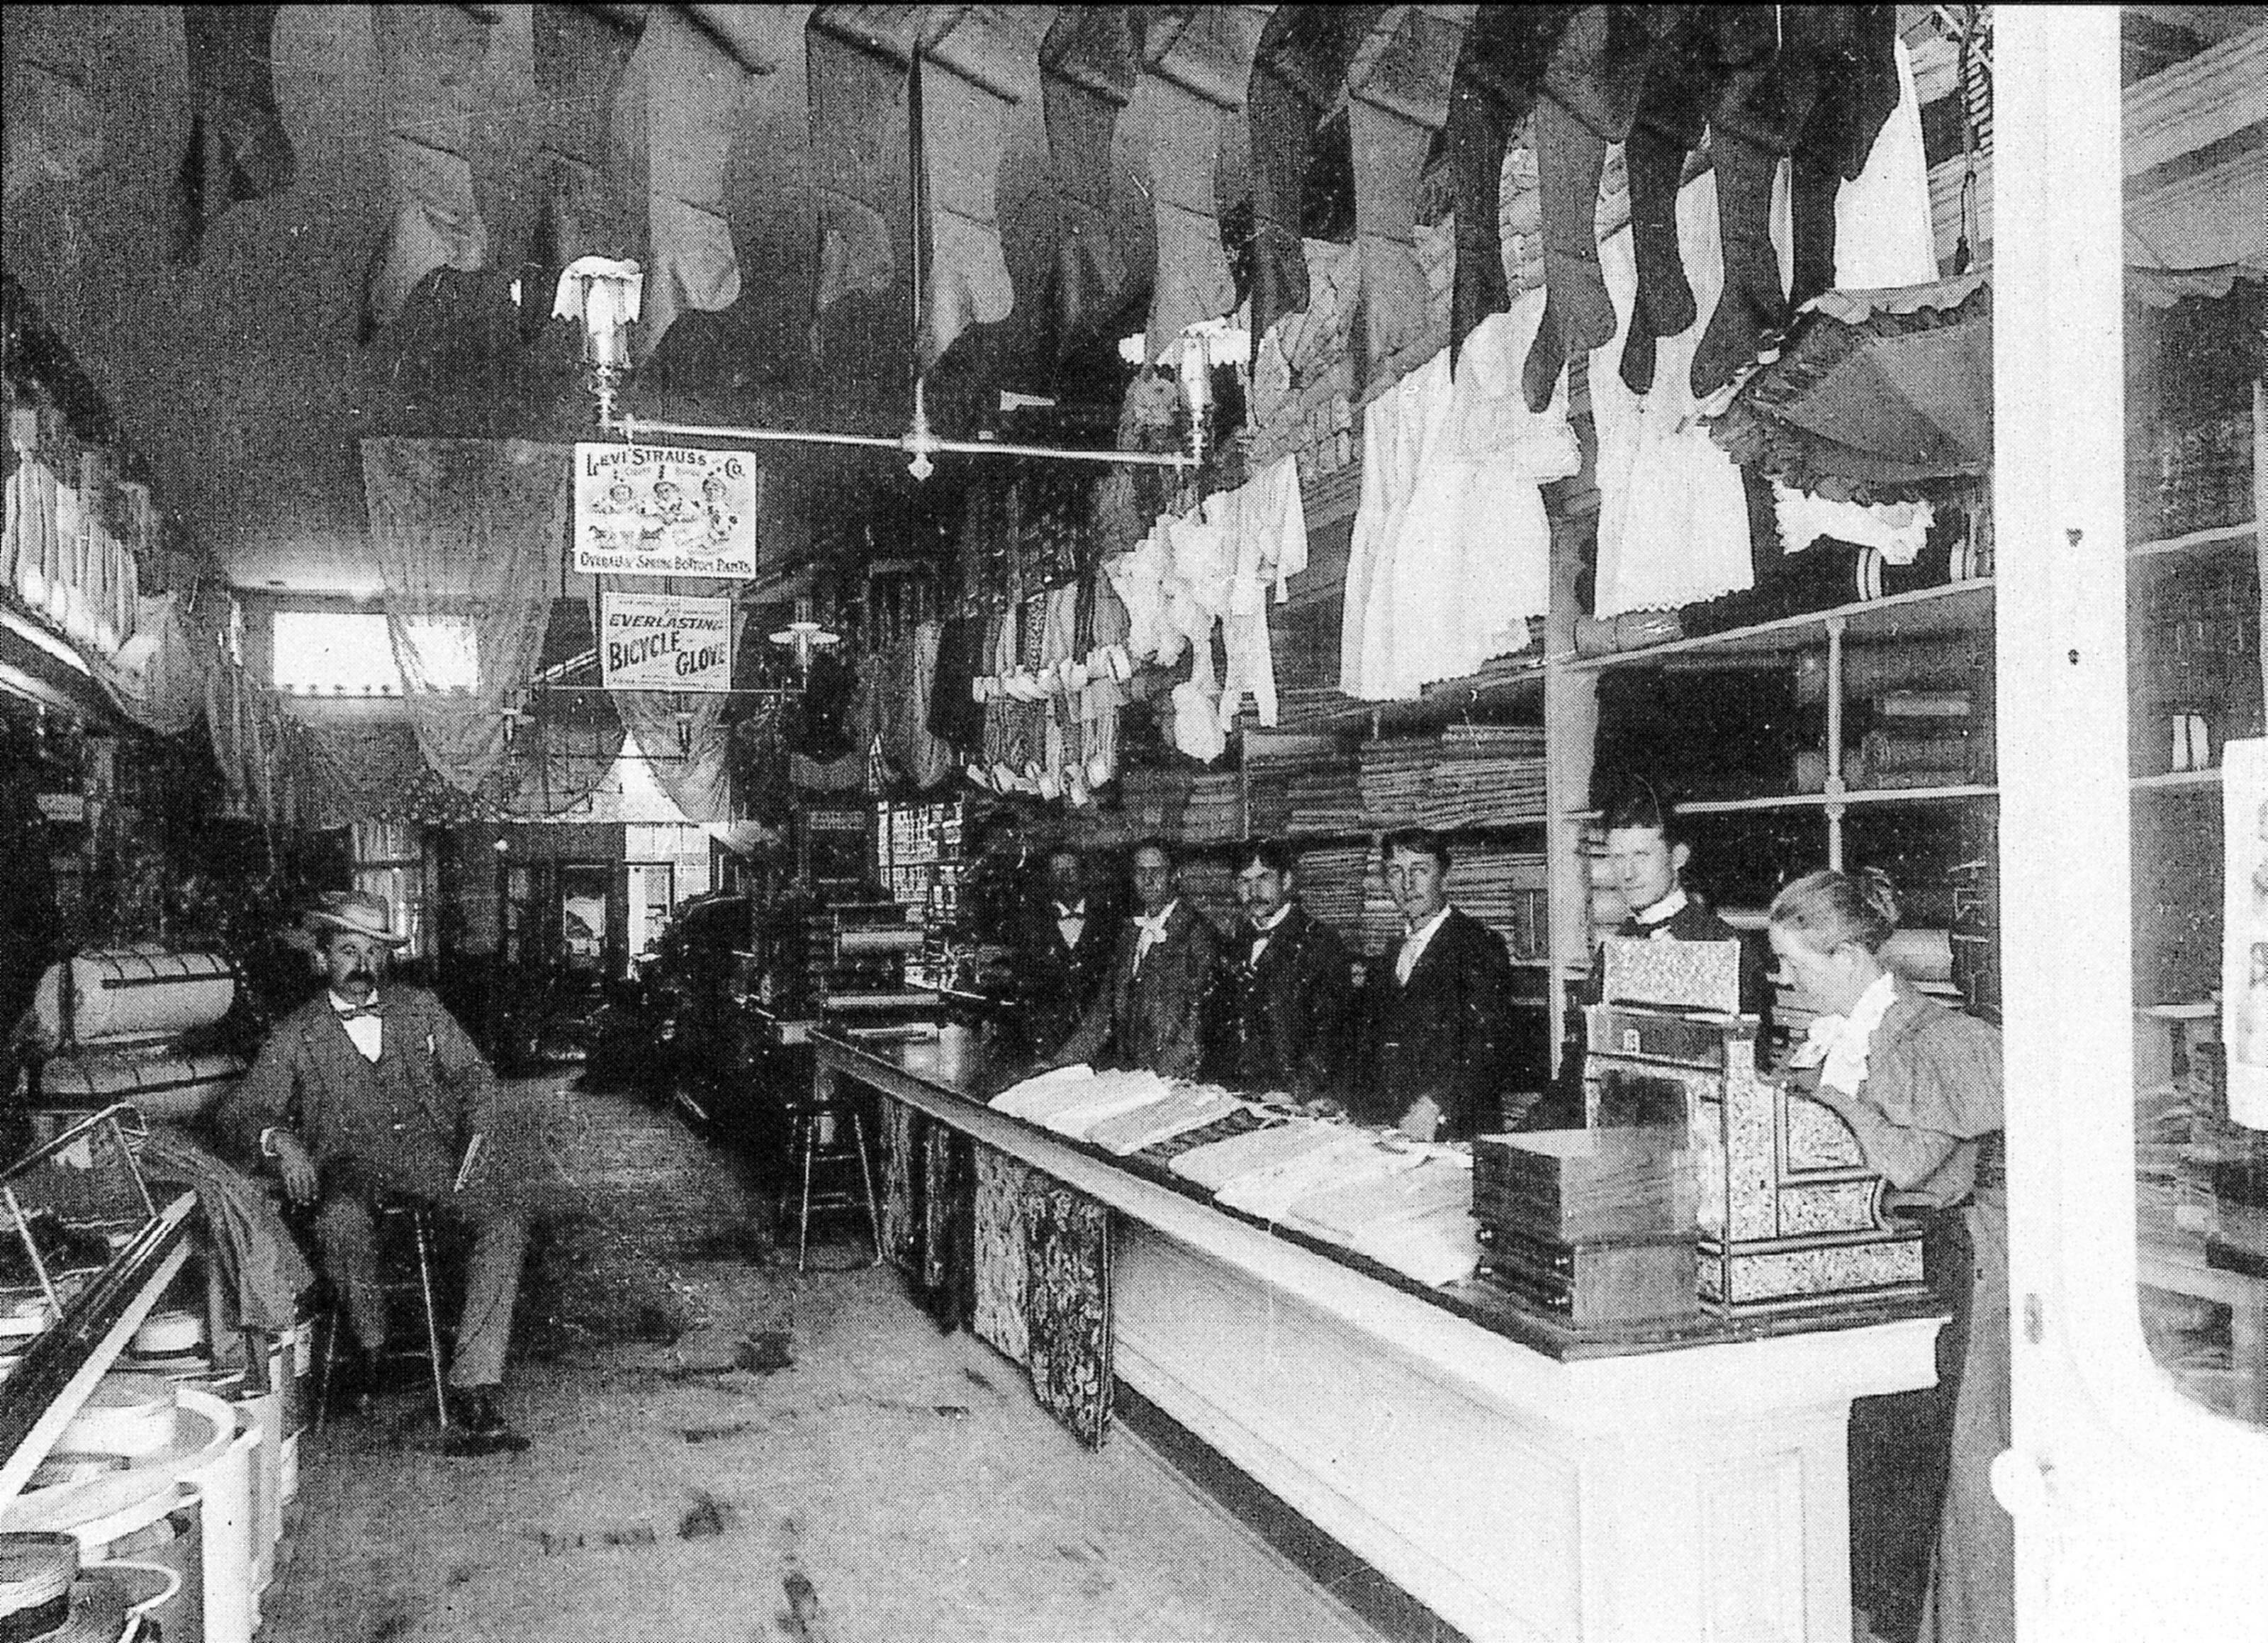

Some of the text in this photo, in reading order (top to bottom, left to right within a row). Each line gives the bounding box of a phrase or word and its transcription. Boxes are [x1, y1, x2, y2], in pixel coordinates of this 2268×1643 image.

[587, 451, 627, 477] LEVI
[632, 448, 707, 466] STRAUSS
[609, 613, 724, 632] EVERLASTING
[609, 630, 682, 673] BICYCLE
[675, 641, 726, 677] GLOVE
